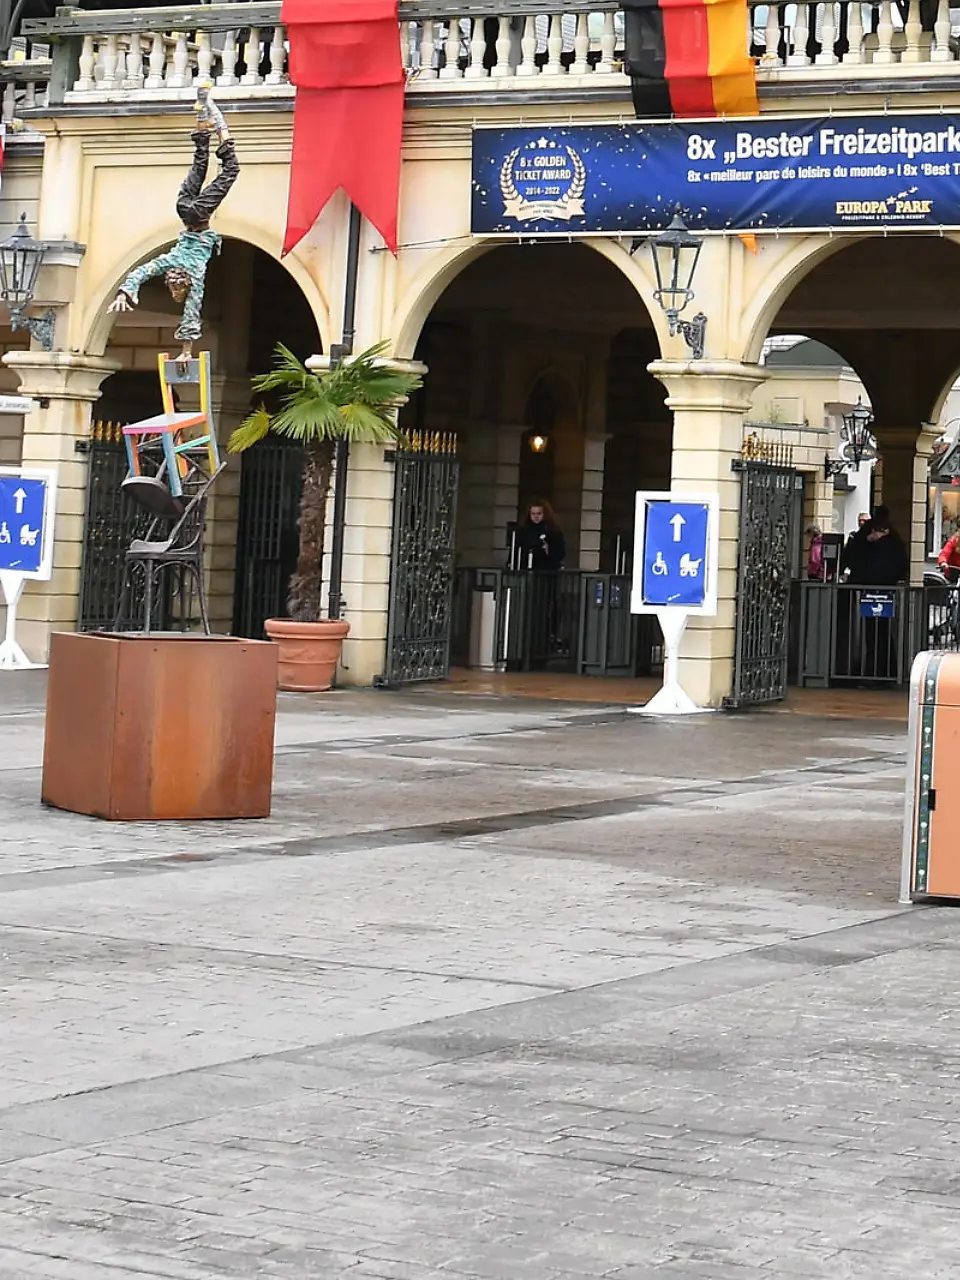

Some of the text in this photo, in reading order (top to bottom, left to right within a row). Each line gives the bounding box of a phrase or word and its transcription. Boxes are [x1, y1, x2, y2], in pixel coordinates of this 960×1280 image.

[687, 133, 716, 160] 8x
[534, 155, 567, 167] GOLDEN
[515, 169, 571, 180] TICKET AWARD
[687, 169, 701, 182] 8x
[756, 169, 780, 184] parc
[781, 166, 796, 179] de
[798, 166, 831, 179] loisirs
[833, 165, 847, 177] du
[903, 163, 918, 176] 8x
[836, 200, 933, 214] EUROPA PARK
